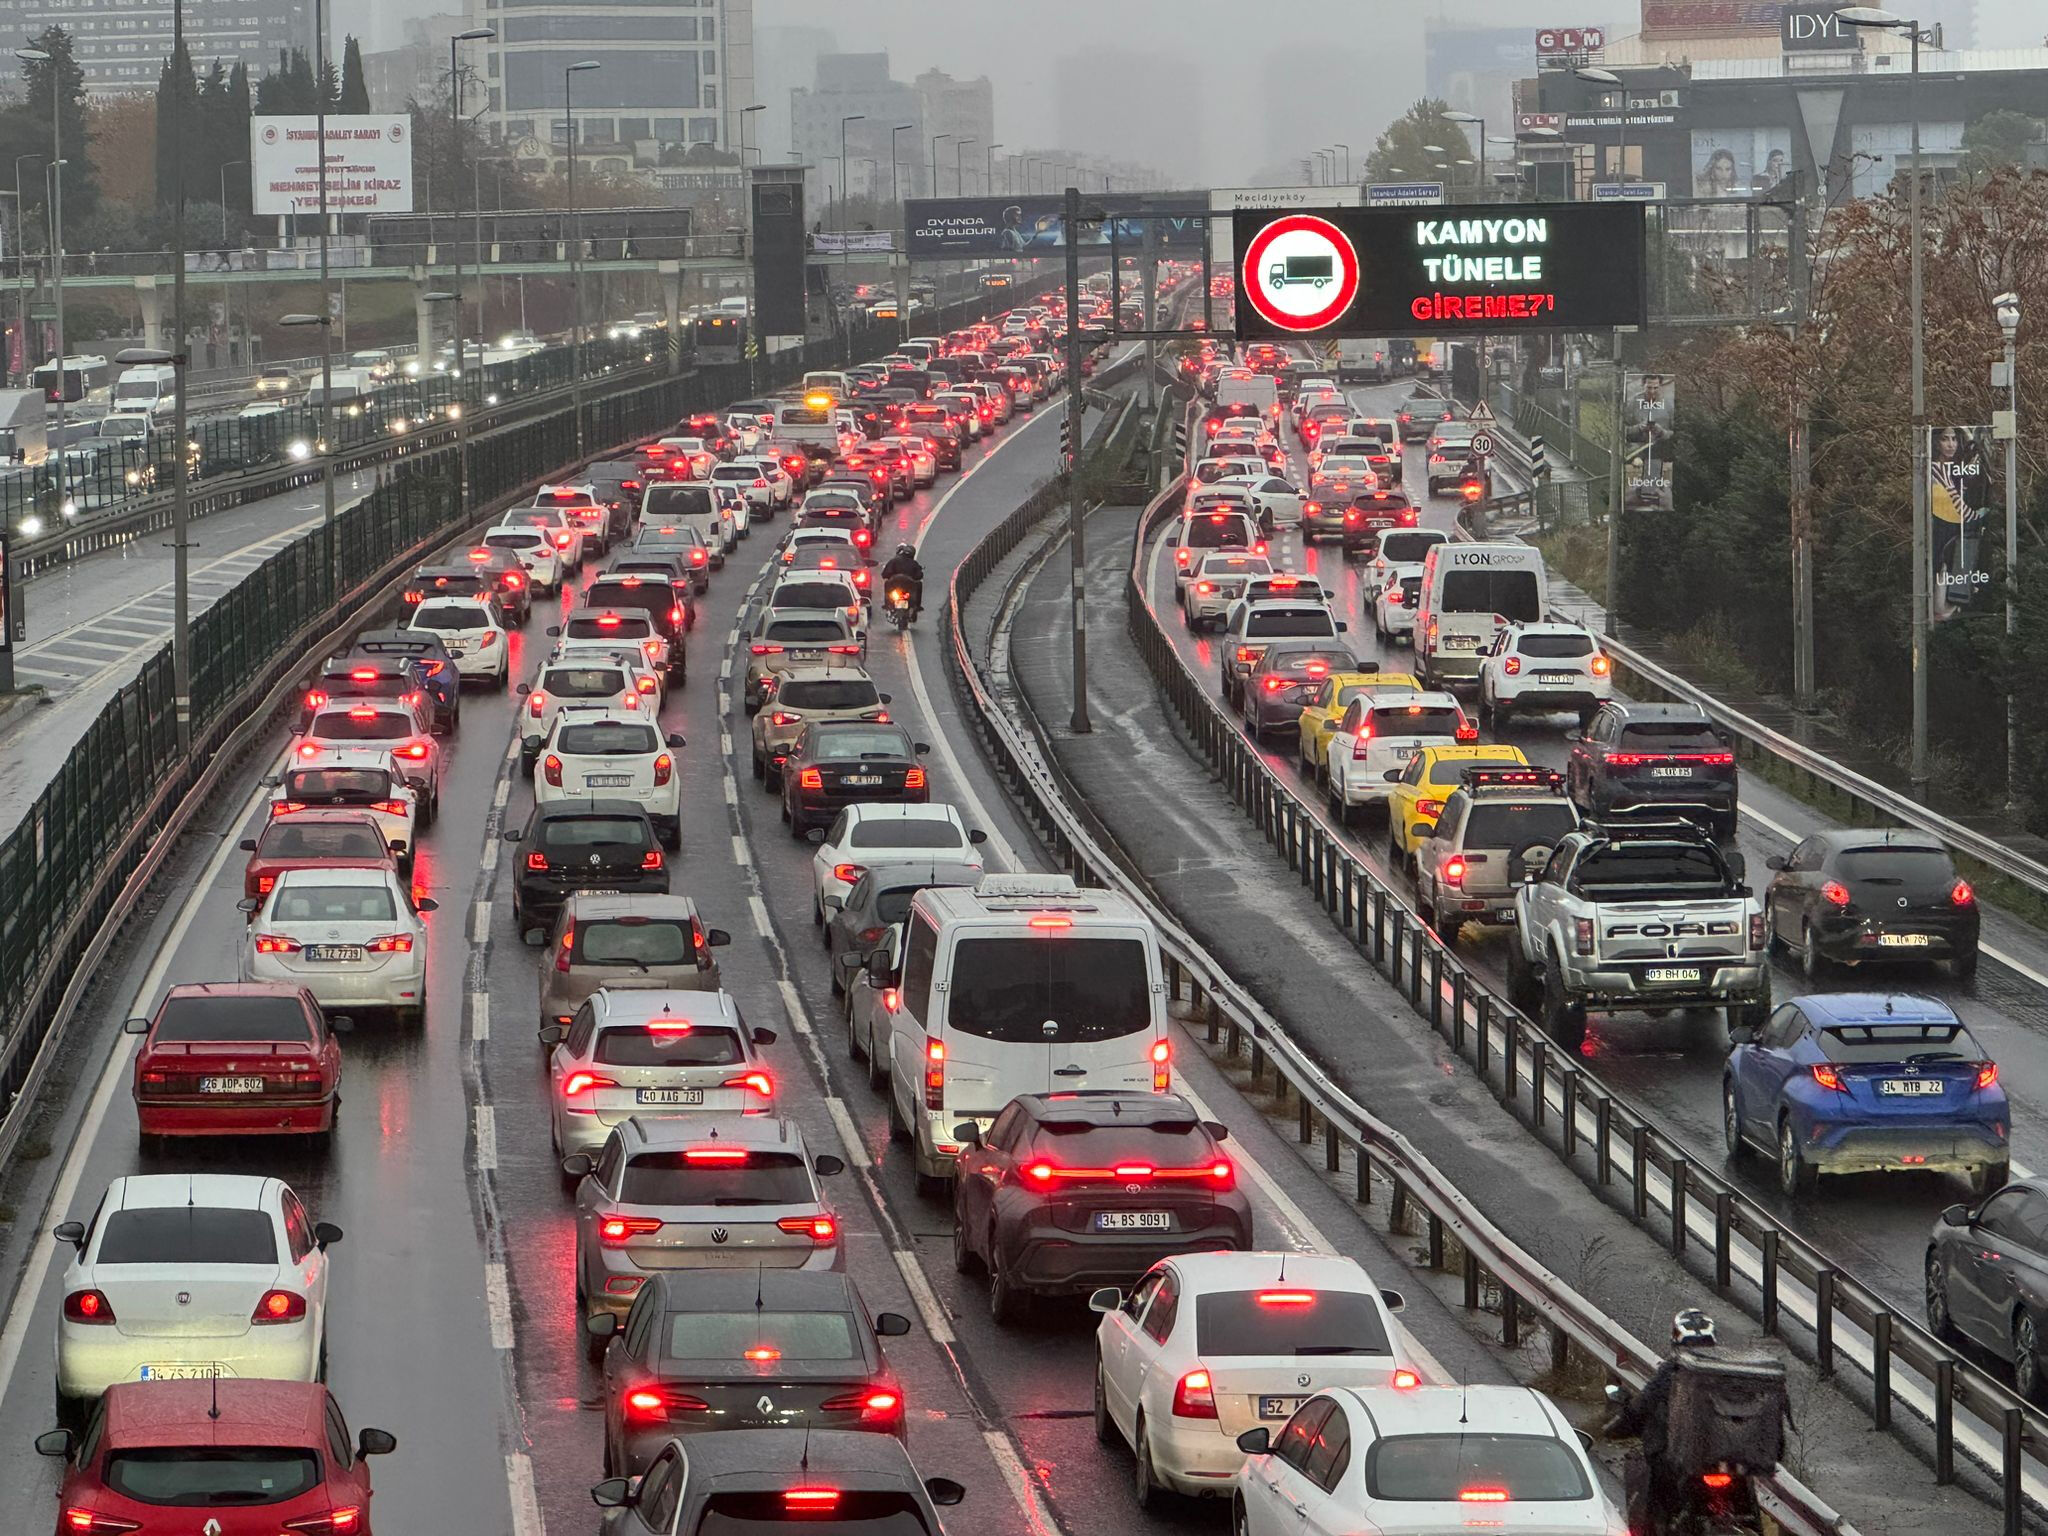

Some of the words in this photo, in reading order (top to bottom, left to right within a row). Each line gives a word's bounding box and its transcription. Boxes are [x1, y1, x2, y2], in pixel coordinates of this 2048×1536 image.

[1789, 13, 1849, 38] IDYL
[364, 178, 401, 190] KİRAZ
[1234, 194, 1306, 202] Mecidiyeköy
[927, 217, 984, 226] OYUNDA
[916, 228, 944, 238] GÜÇ
[1417, 218, 1547, 245] KAMYON
[1422, 254, 1542, 282] TÜNELE
[1637, 398, 1665, 410] Taksi
[1475, 438, 1490, 451] 30
[1944, 461, 1980, 476] Taksi
[1628, 477, 1671, 488] Uber'de
[1454, 554, 1490, 565] LYON
[1936, 570, 1990, 586] Uber'de
[1607, 922, 1739, 938] FORD
[1650, 970, 1661, 979] 03
[1666, 970, 1679, 978] BH
[1682, 970, 1698, 978] 047
[206, 1078, 216, 1089] 26
[222, 1078, 239, 1089] ADP
[244, 1078, 261, 1089] 602
[1884, 1082, 1896, 1092] 34
[1929, 1081, 1940, 1092] 22
[644, 1092, 656, 1102] 40
[661, 1092, 678, 1102] AAG
[684, 1092, 700, 1102] 731
[1103, 1214, 1116, 1226] 34
[1122, 1214, 1134, 1226] BS
[1140, 1214, 1166, 1226] 9091
[1268, 1400, 1283, 1414] 52
